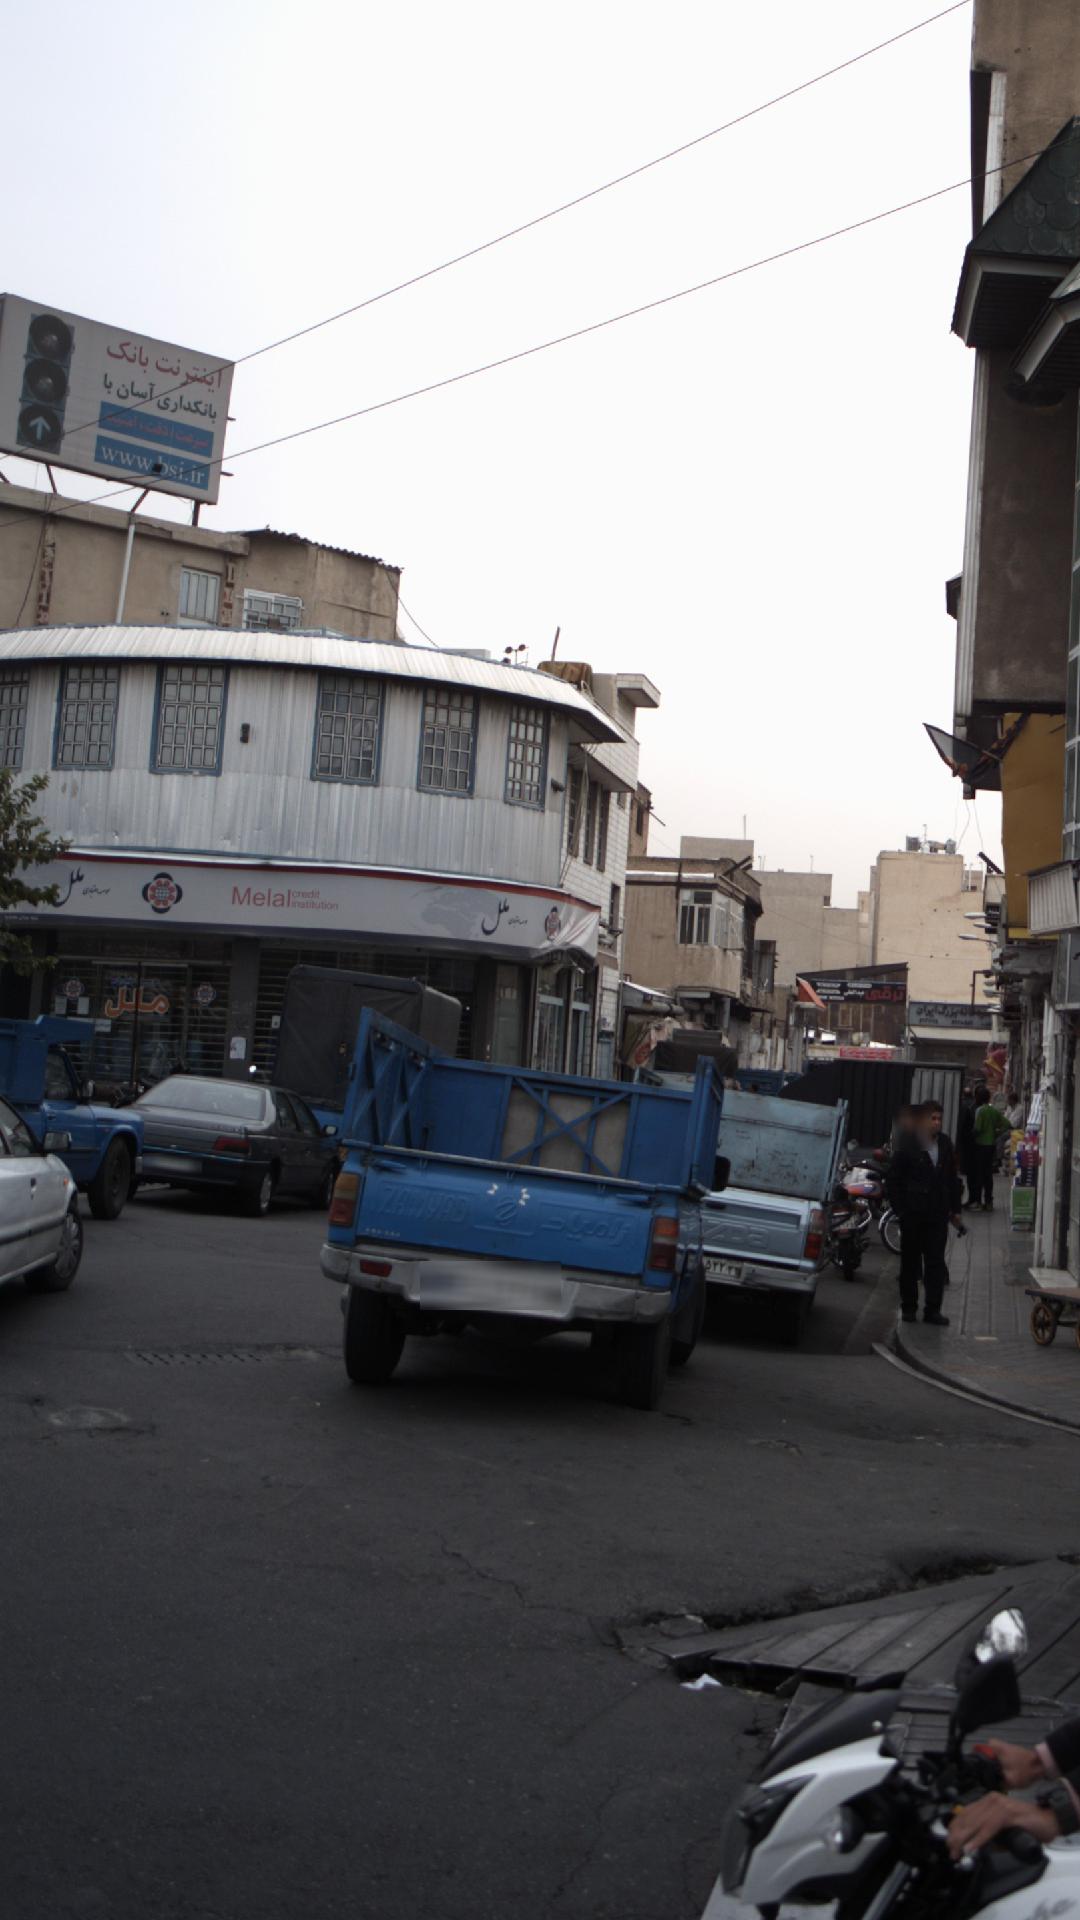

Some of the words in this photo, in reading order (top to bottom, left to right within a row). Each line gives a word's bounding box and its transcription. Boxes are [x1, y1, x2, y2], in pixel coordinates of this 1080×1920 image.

[106, 342, 149, 374] بانک
[103, 372, 113, 394] با
[156, 357, 223, 393] اینترنت
[116, 380, 156, 401] آسان
[157, 395, 217, 424] بانکداری
[101, 446, 205, 484] wwwbsi.ir
[231, 885, 291, 908] Melal
[291, 887, 321, 899] credit
[291, 899, 339, 911] institution
[104, 986, 170, 1018] ملل
